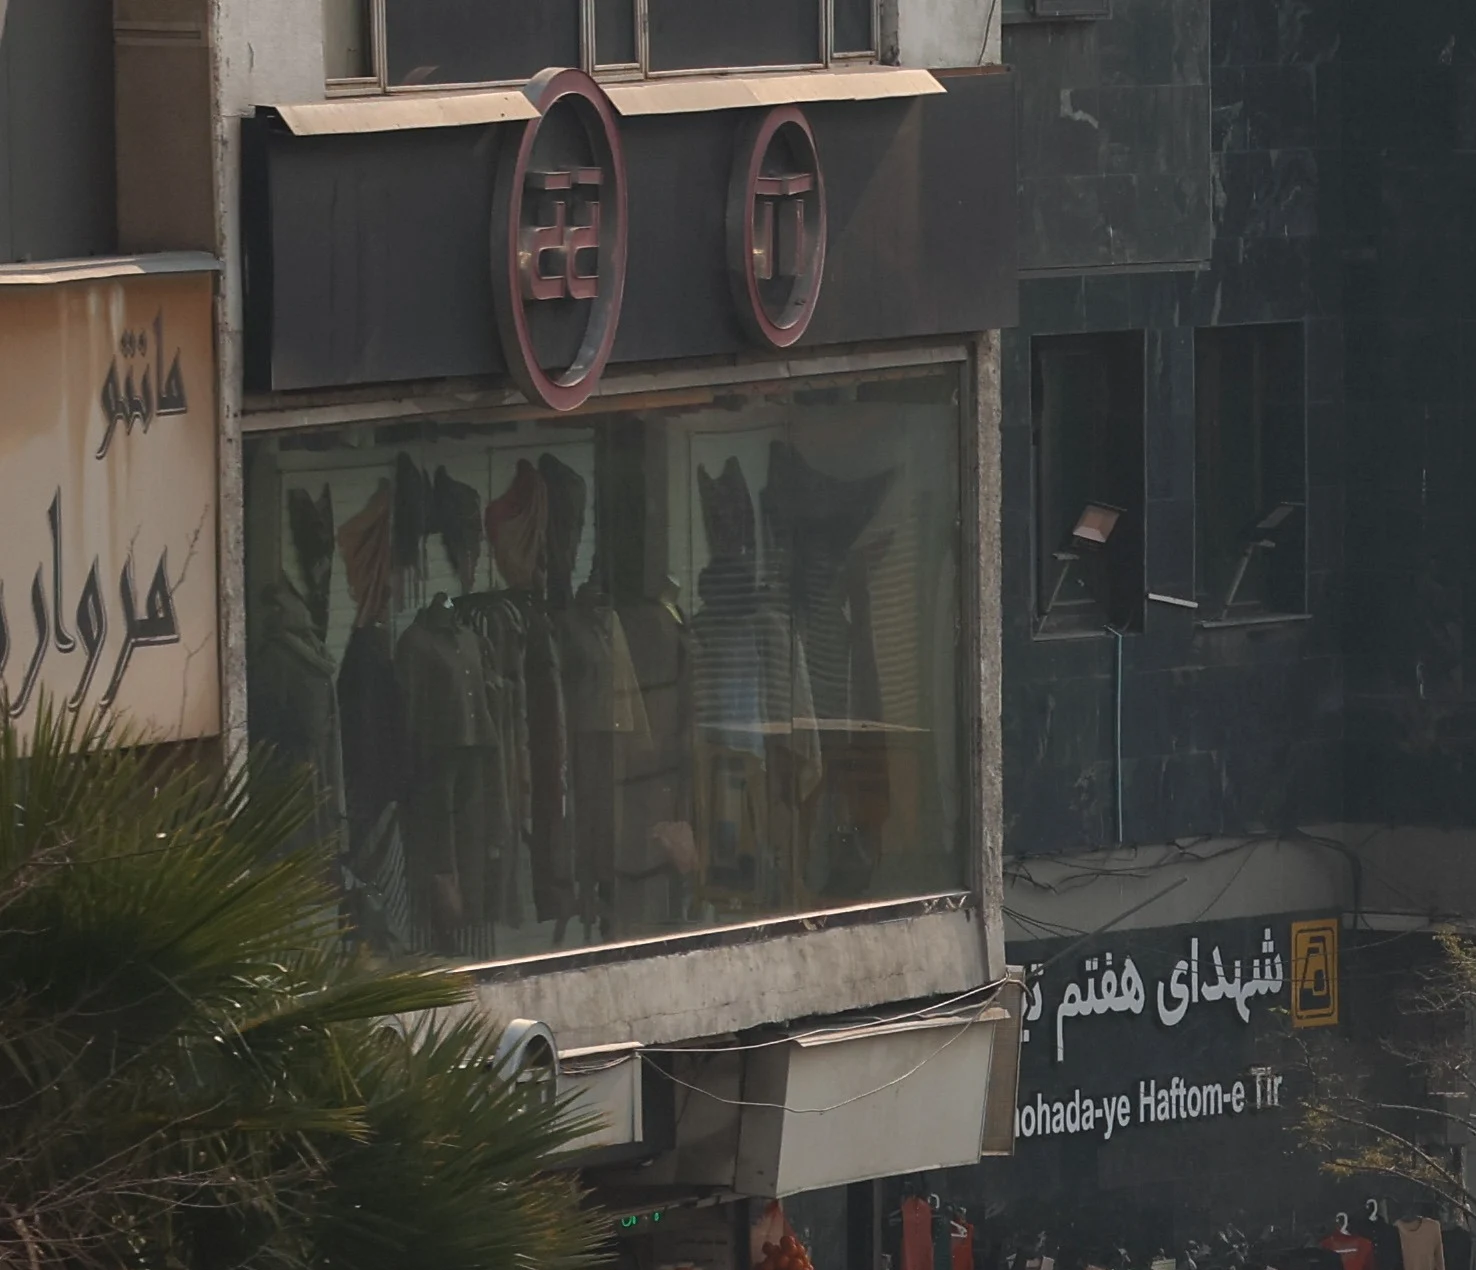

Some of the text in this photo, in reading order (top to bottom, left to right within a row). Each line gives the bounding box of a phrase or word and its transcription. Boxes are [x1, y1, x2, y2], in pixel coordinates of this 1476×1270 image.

[95, 306, 187, 460] مانتو
[0, 486, 182, 718] مروار
[1056, 951, 1144, 1062] هفتم
[1157, 927, 1283, 1025] شهدای
[1139, 1076, 1245, 1124] Haftom-e
[1251, 1067, 1283, 1109] Tir
